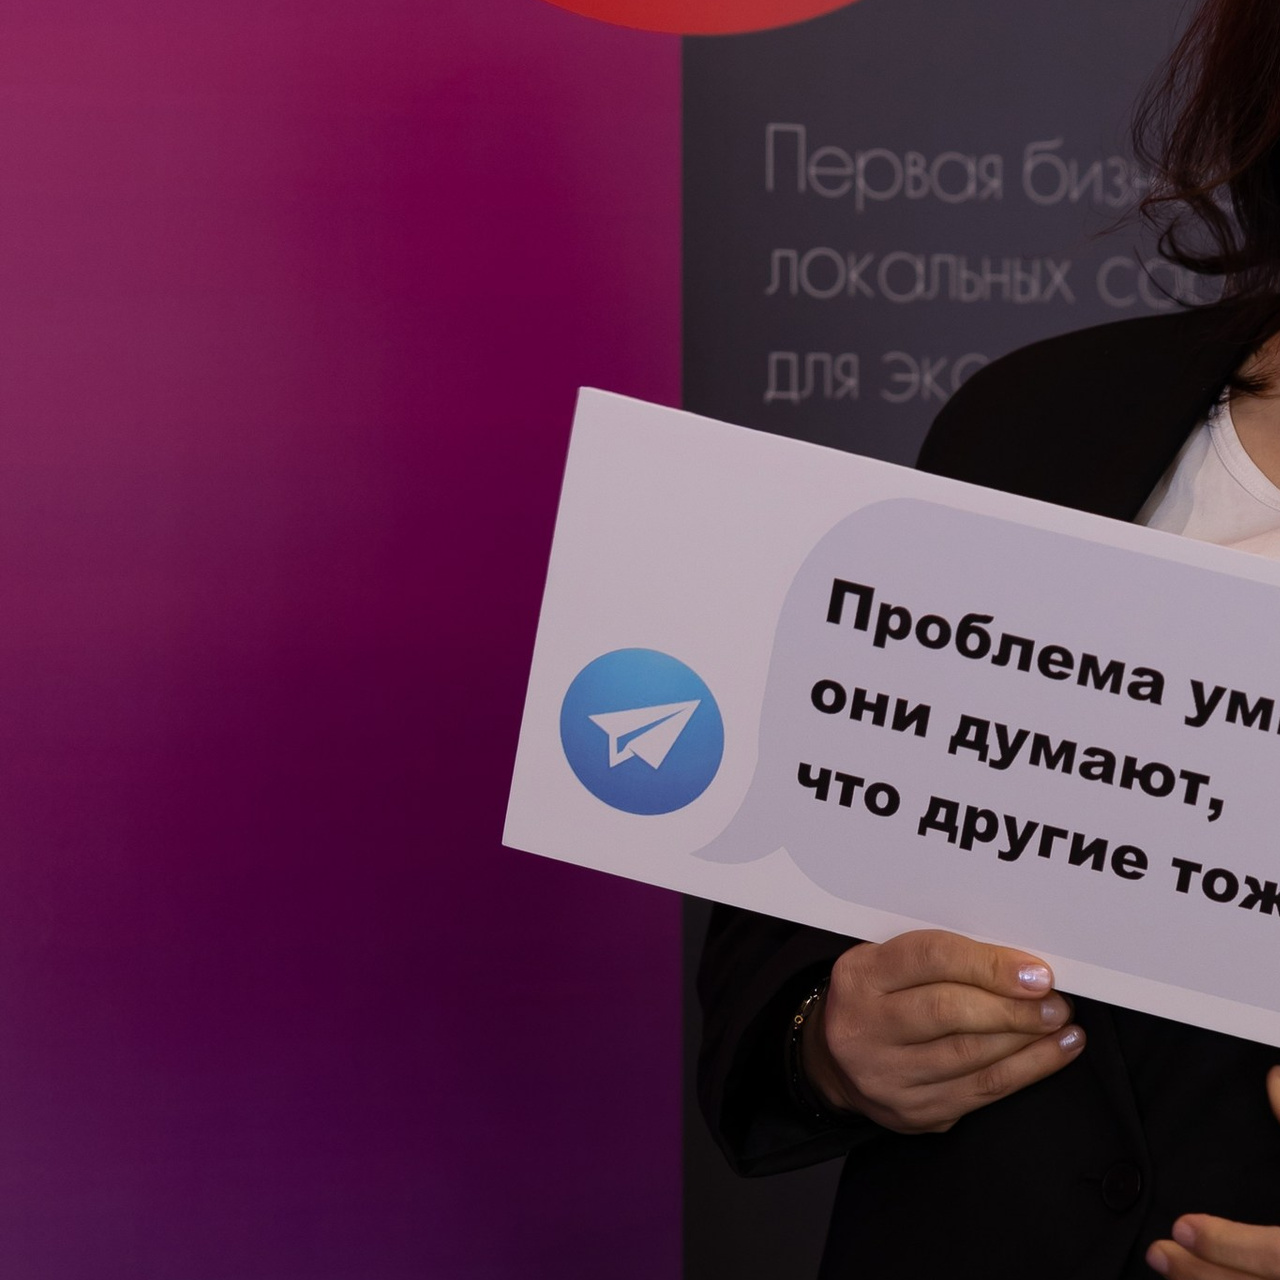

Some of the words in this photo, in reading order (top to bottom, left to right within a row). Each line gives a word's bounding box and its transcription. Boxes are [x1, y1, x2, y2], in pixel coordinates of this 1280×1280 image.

[763, 122, 1004, 213] Первая
[762, 246, 1077, 306] локальных
[762, 350, 862, 405] для
[826, 577, 1165, 706] Проблема
[810, 679, 932, 738] они
[947, 713, 1224, 823] думают,
[797, 762, 901, 817] что
[917, 795, 1149, 881] другие
